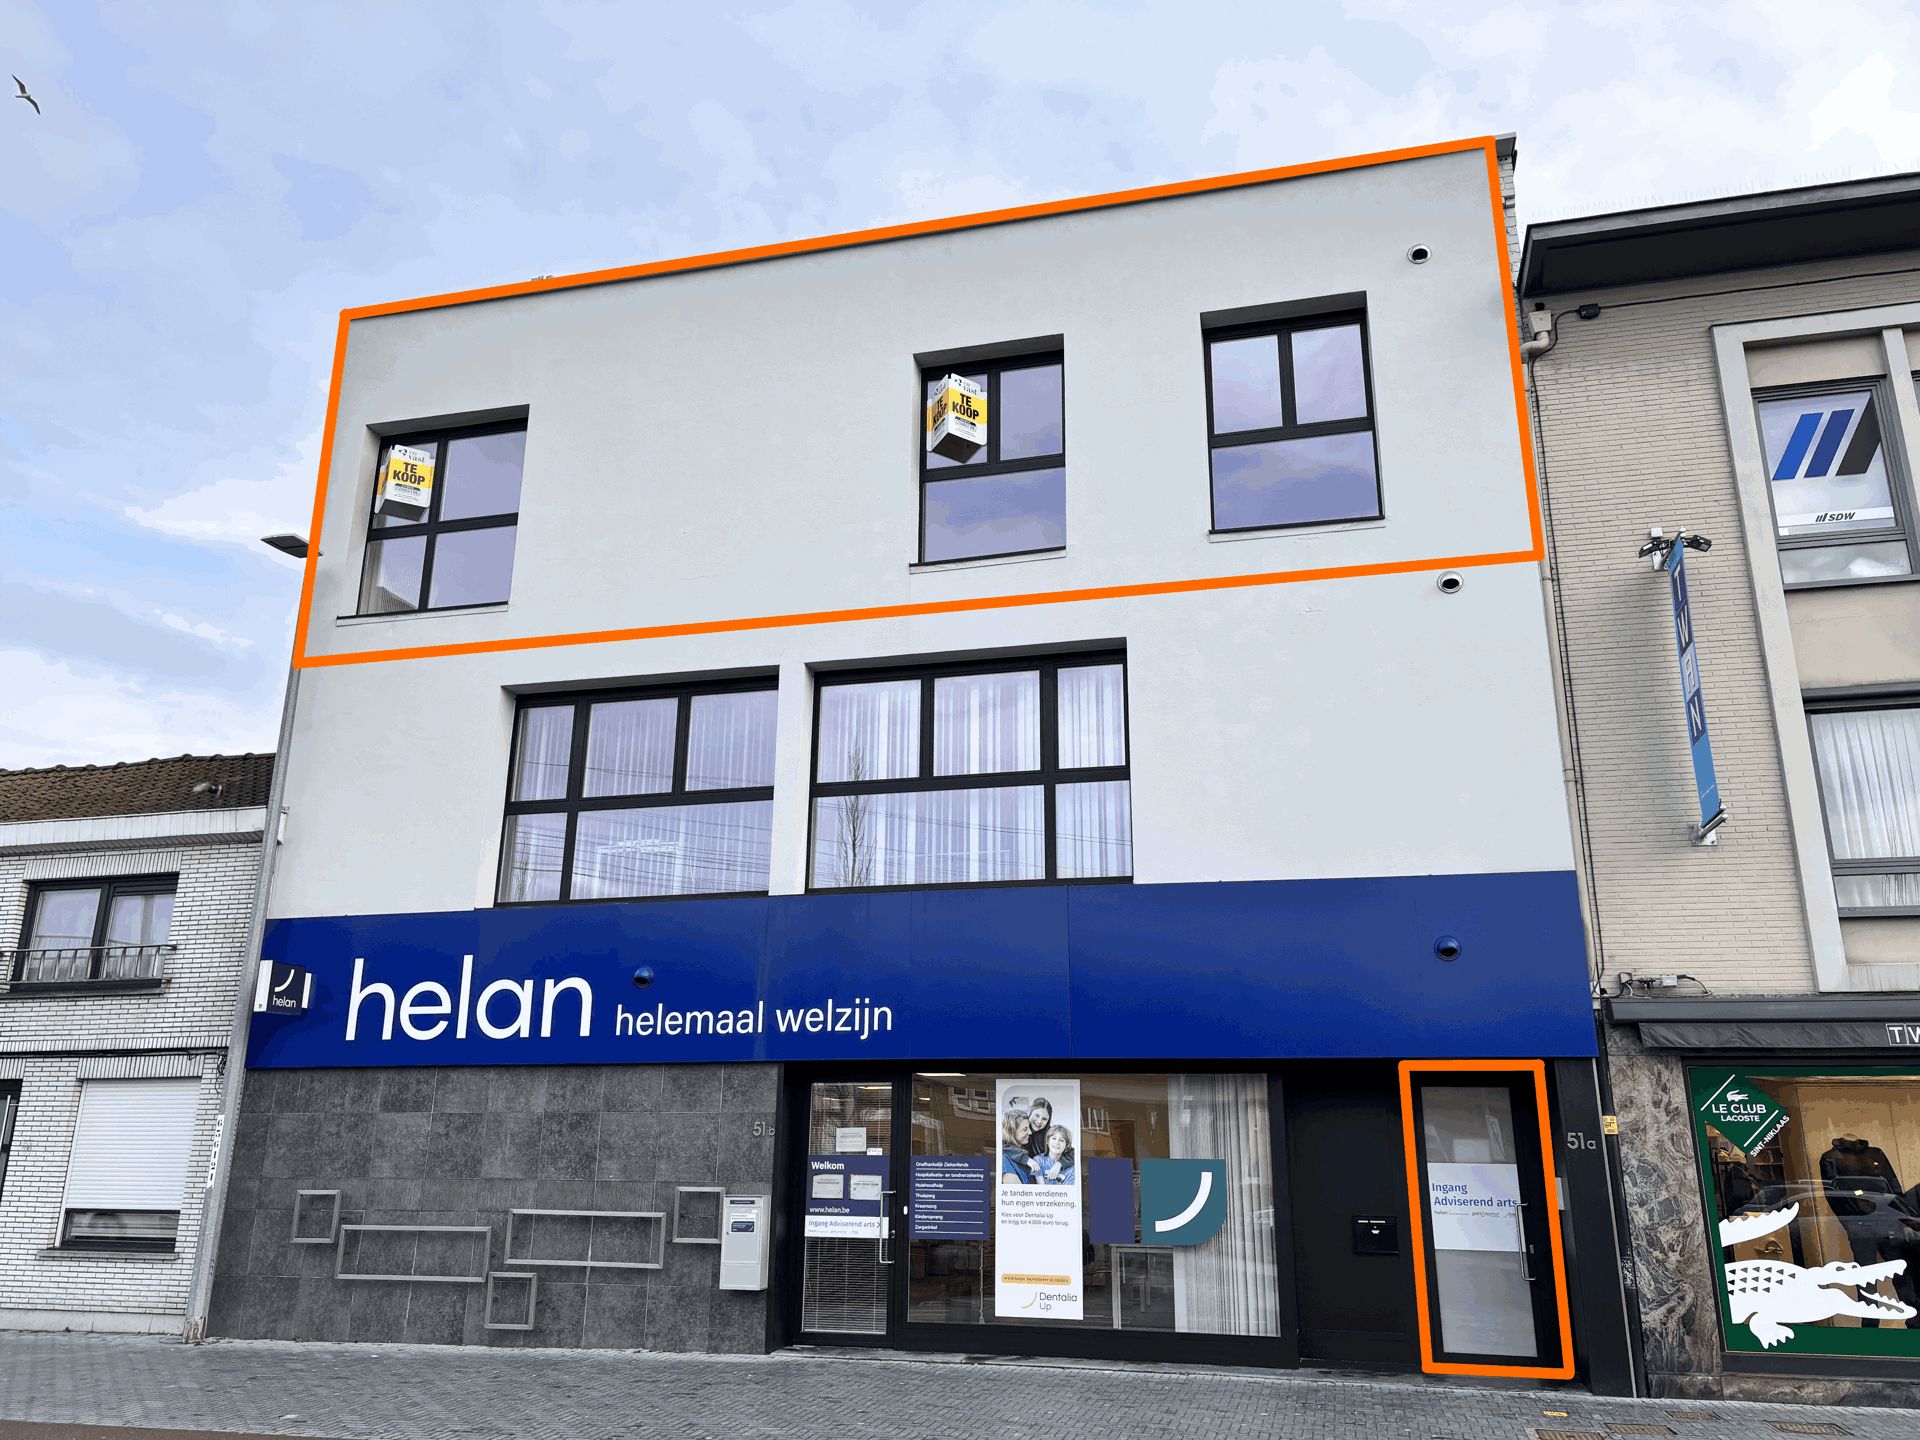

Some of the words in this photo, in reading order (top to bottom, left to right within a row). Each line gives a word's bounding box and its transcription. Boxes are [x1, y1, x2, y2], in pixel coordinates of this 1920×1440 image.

[960, 393, 972, 407] TE
[952, 401, 979, 420] KOOP
[403, 462, 418, 474] TE
[392, 470, 425, 485] KOOP
[1828, 512, 1856, 521] SDW
[272, 995, 296, 1008] helan
[345, 954, 593, 1041] helan
[615, 1000, 764, 1036] helemaal
[775, 997, 893, 1040] welzijn
[1711, 1103, 1728, 1114] LE
[1730, 1103, 1767, 1114] CLUB
[1720, 1114, 1761, 1122] LACOSTE
[1567, 1132, 1597, 1150] 51a
[1750, 1115, 1790, 1157] SINT-NIKLAAS
[811, 1161, 845, 1170] Welkom
[1432, 1183, 1468, 1195] Ingang
[1036, 1200, 1076, 1208] verzekering.
[1434, 1196, 1493, 1207] Adviserend
[1496, 1198, 1518, 1207] arts
[808, 1220, 829, 1228] Ingang
[829, 1219, 861, 1227] Adviserend
[1039, 1292, 1078, 1302] Dentalia
[1039, 1303, 1052, 1312] Up
